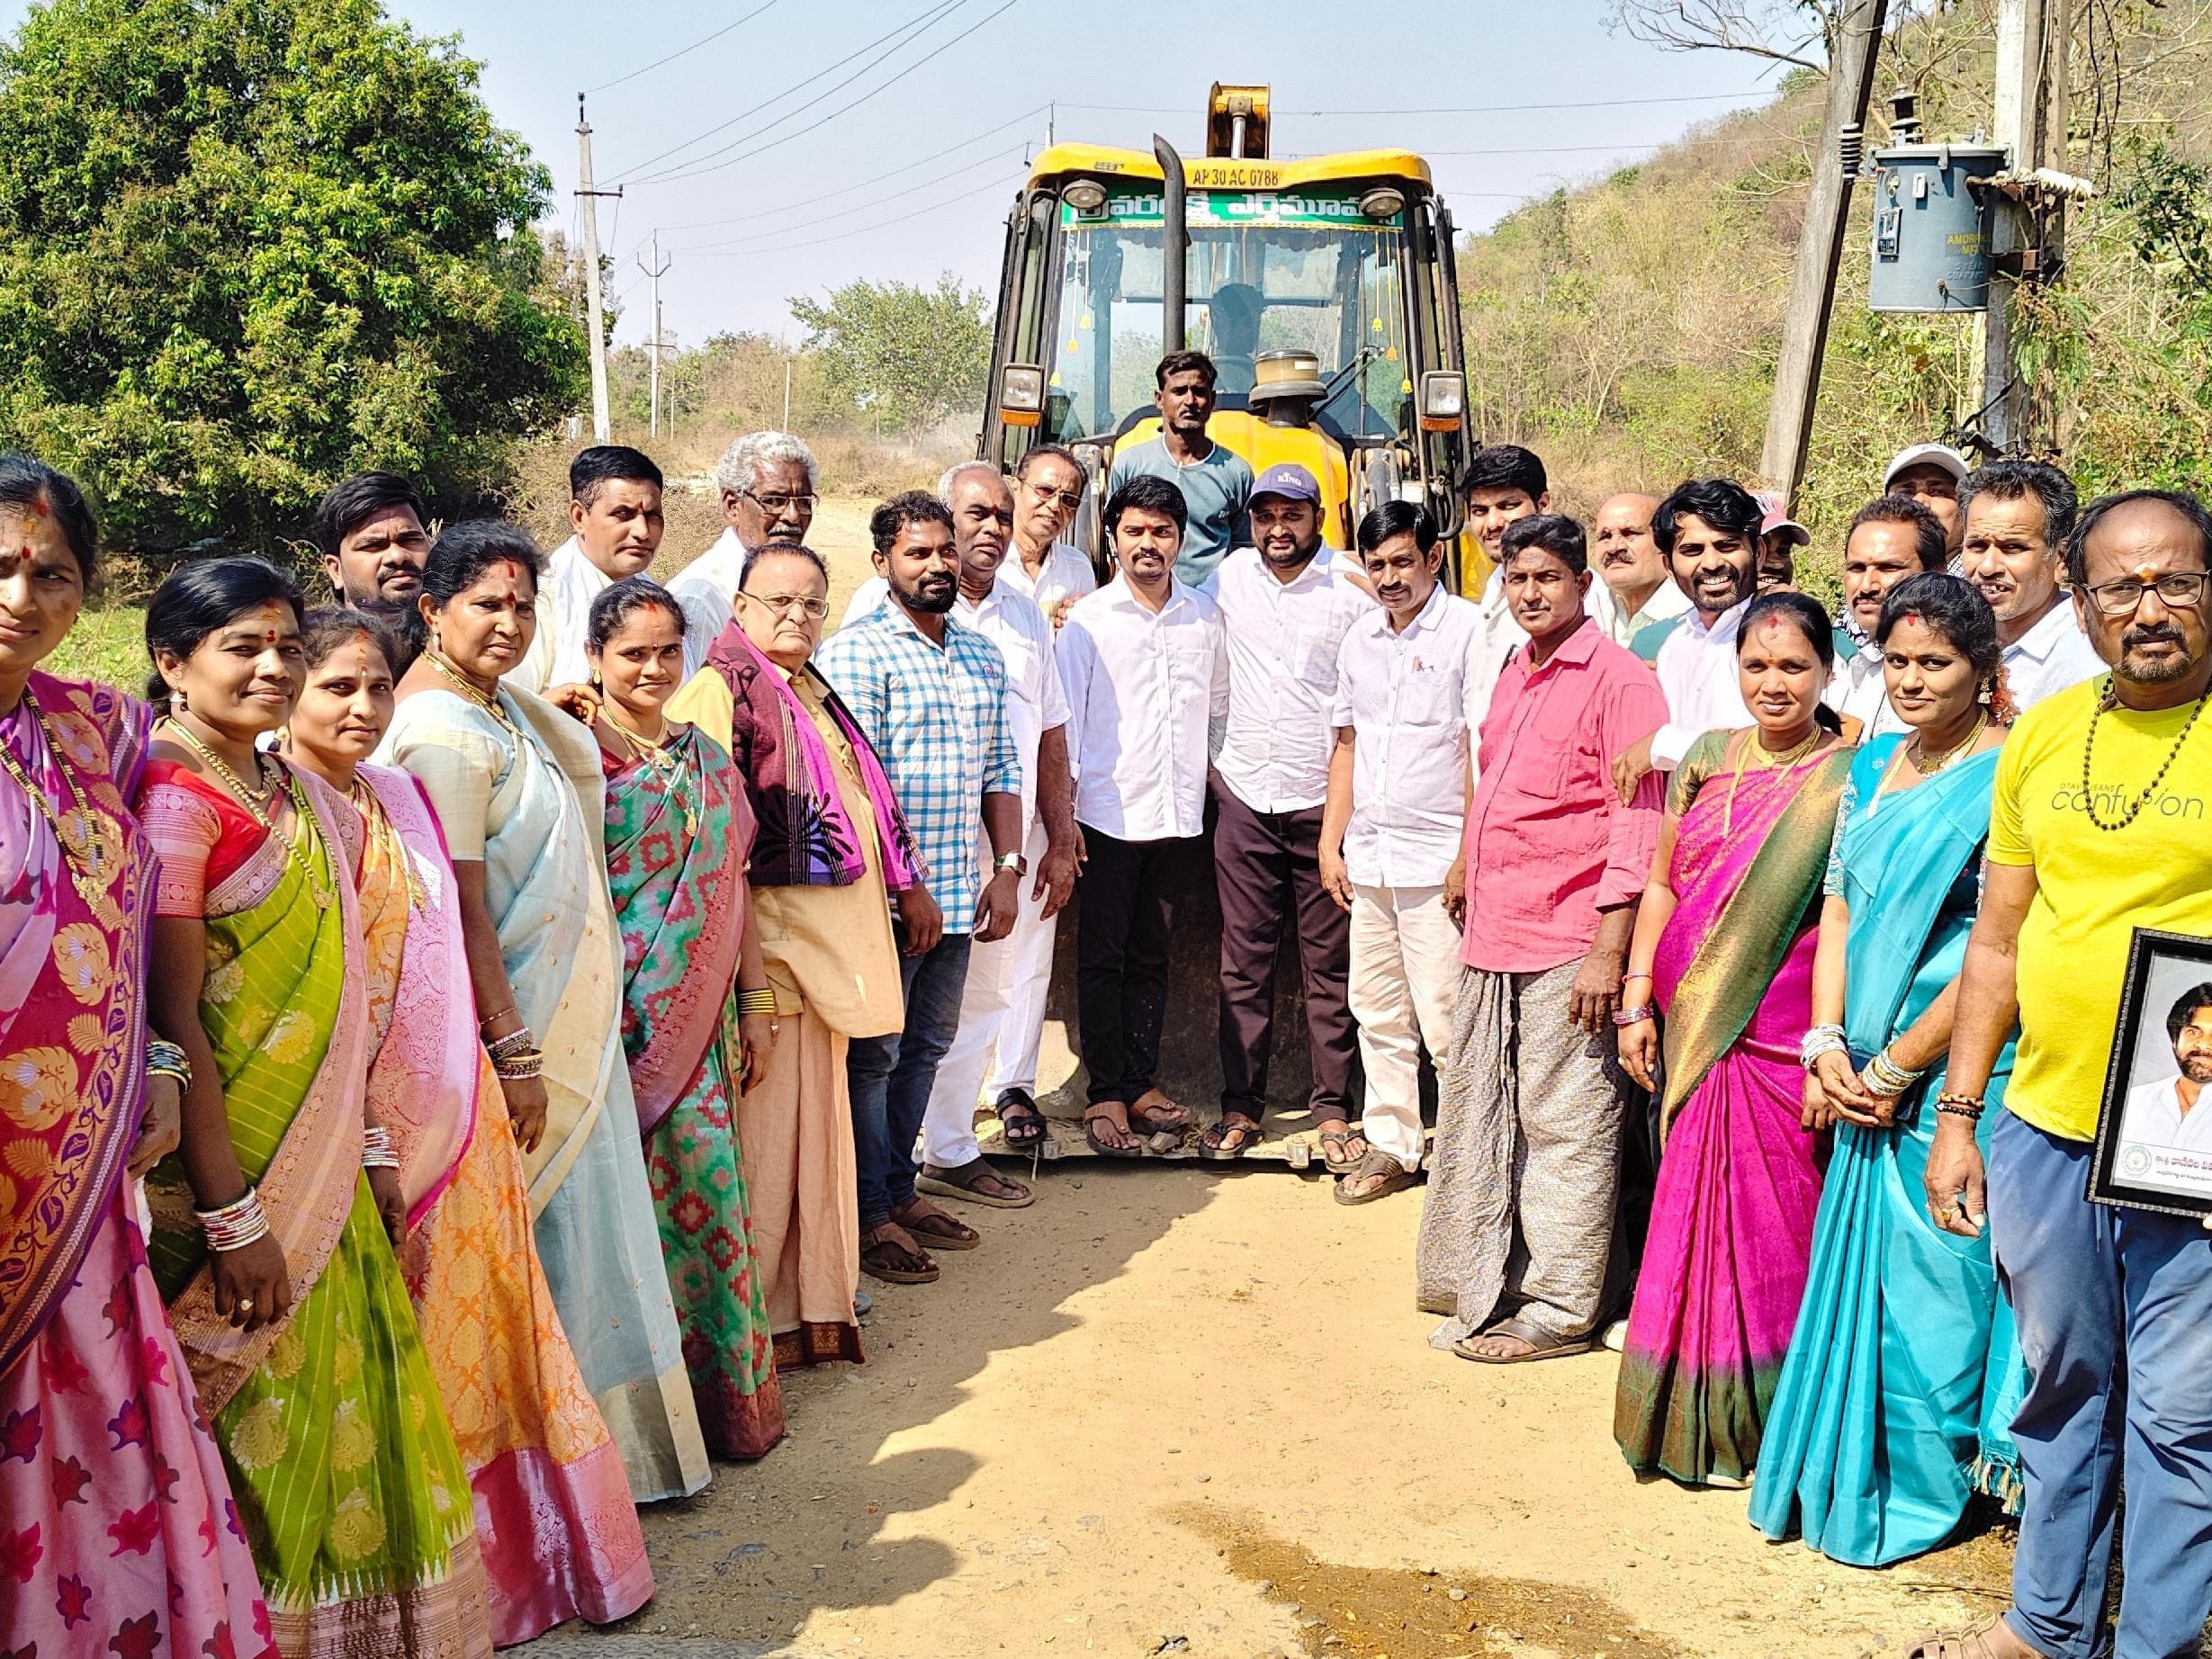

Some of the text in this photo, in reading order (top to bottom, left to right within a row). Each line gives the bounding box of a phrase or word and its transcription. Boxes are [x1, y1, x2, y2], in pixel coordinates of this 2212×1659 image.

[1193, 169, 1279, 186] AP 30 AC 0788
[1277, 472, 1302, 487] KING
